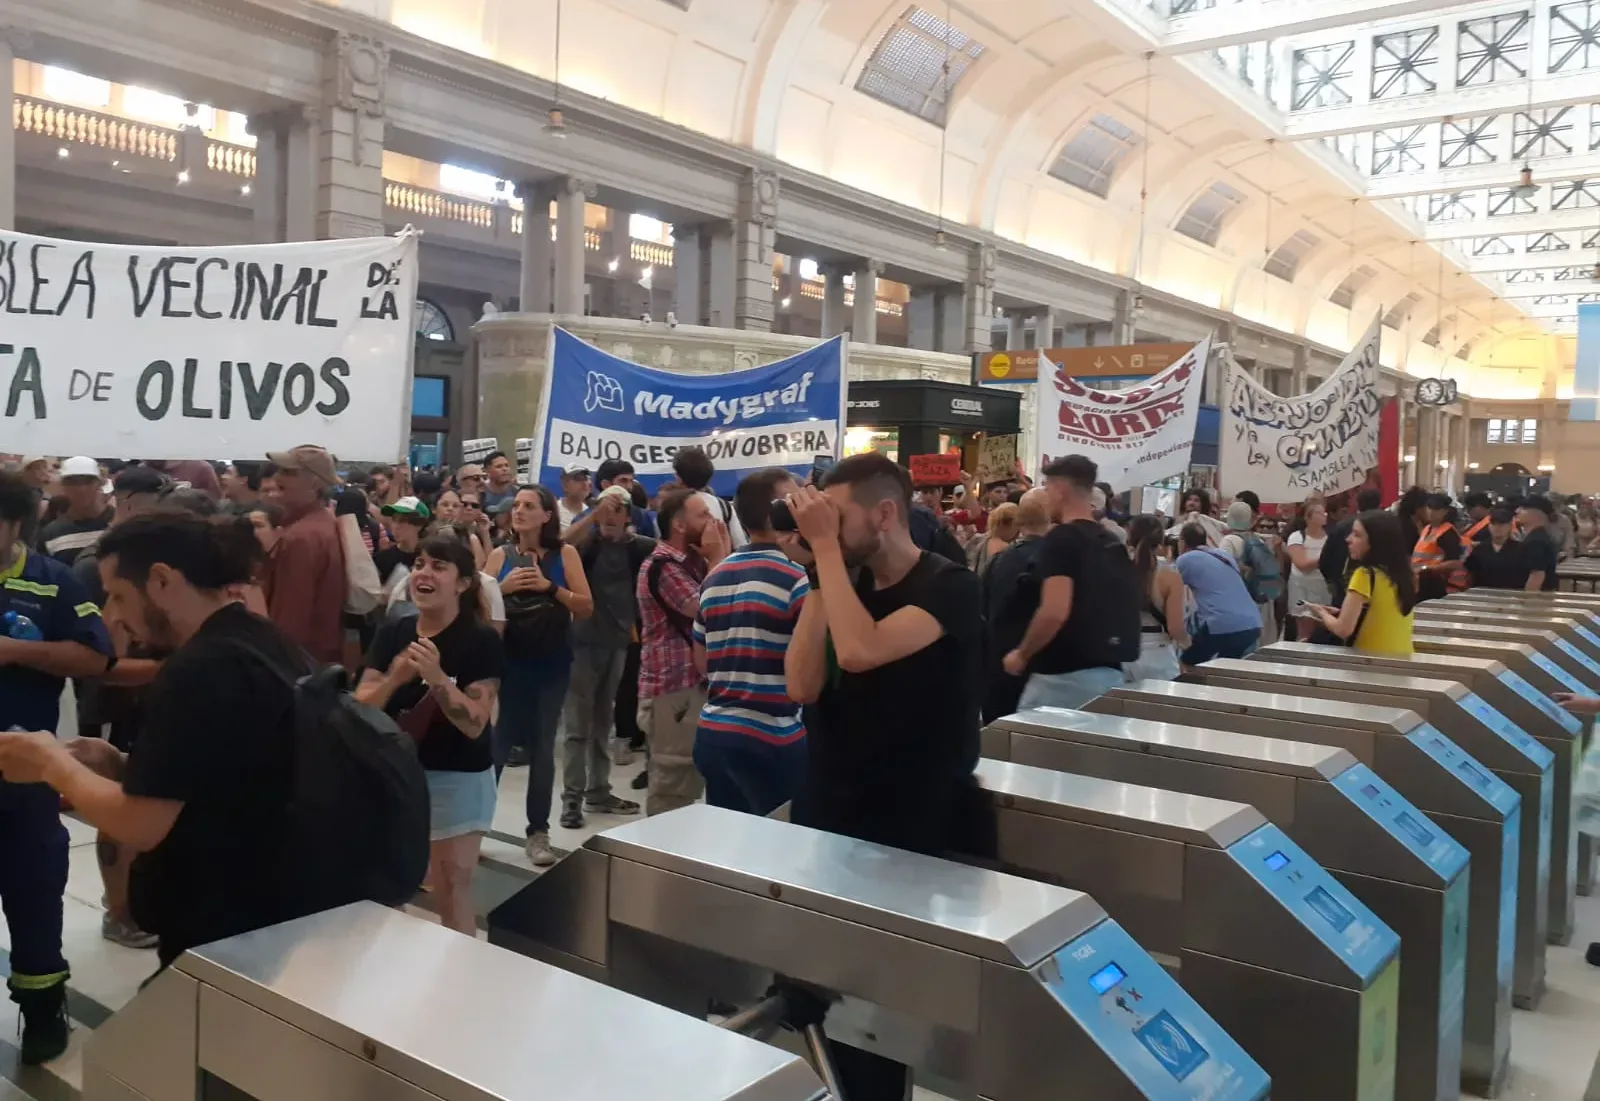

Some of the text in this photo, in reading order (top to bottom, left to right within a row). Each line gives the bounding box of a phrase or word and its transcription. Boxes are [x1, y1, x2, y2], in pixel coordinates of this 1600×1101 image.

[127, 255, 338, 327] VECINAL
[360, 291, 399, 320] LA
[68, 369, 115, 402] DE
[136, 357, 351, 421] OLIVOS
[634, 372, 815, 425] Madygraf
[560, 431, 622, 464] BAJO
[629, 438, 739, 464] GESÓN
[741, 430, 831, 457] OBRERA
